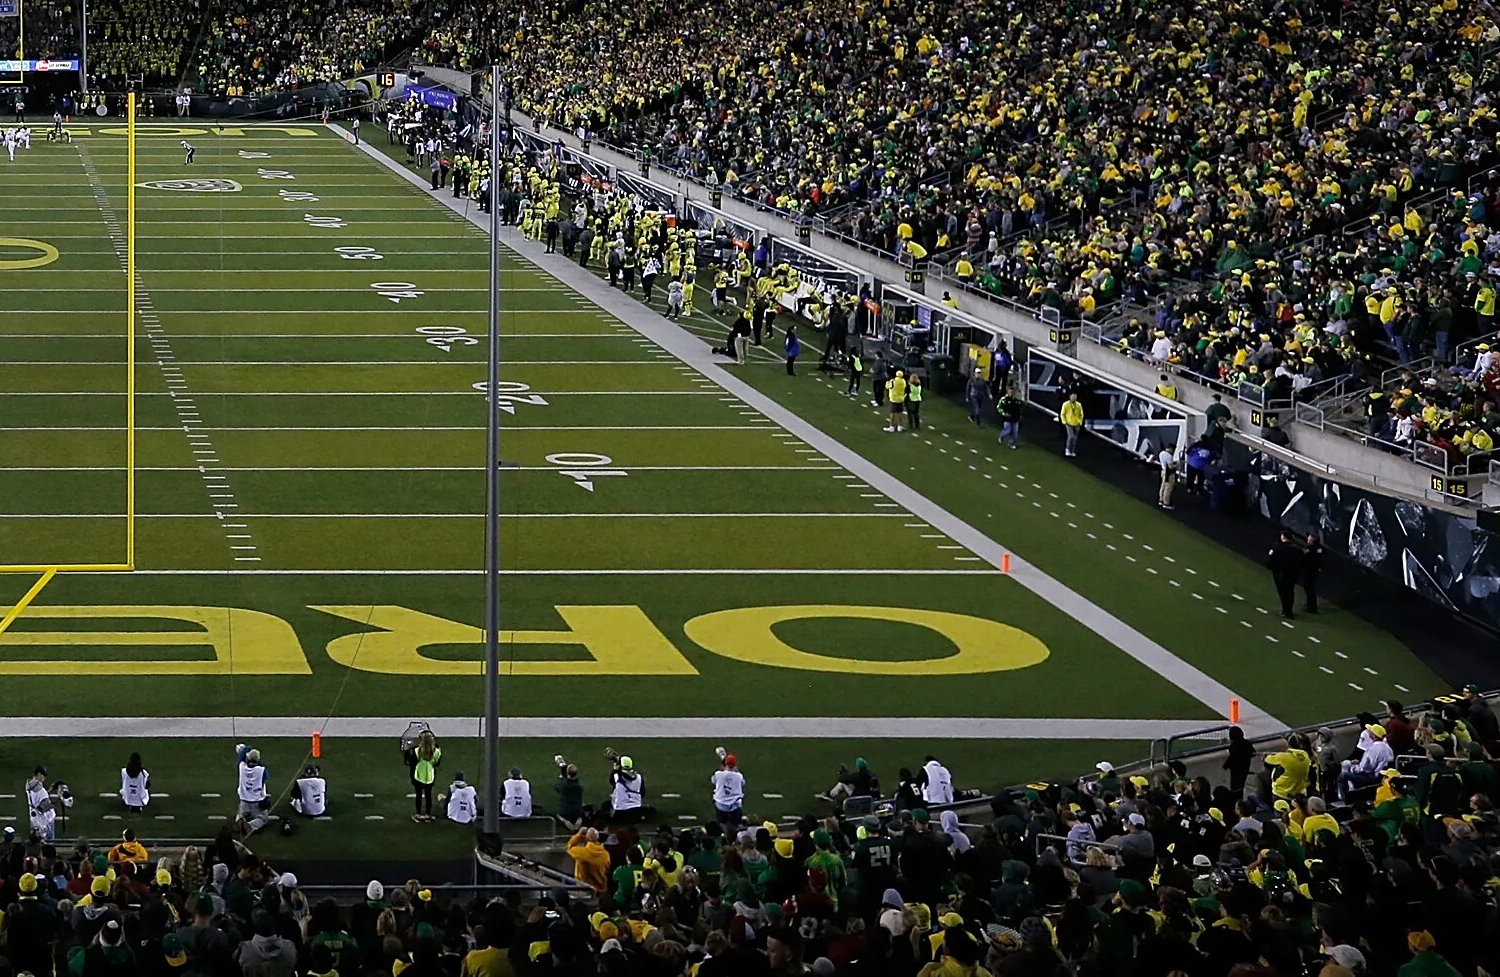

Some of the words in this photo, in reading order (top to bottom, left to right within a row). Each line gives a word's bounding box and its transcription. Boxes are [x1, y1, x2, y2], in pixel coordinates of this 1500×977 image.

[381, 73, 393, 86] 16
[334, 247, 383, 260] 50
[415, 326, 479, 345] 30
[472, 381, 549, 405] 20
[545, 453, 628, 480] 10
[1433, 478, 1442, 491] 15
[1450, 485, 1465, 493] 15
[869, 845, 891, 867] 24
